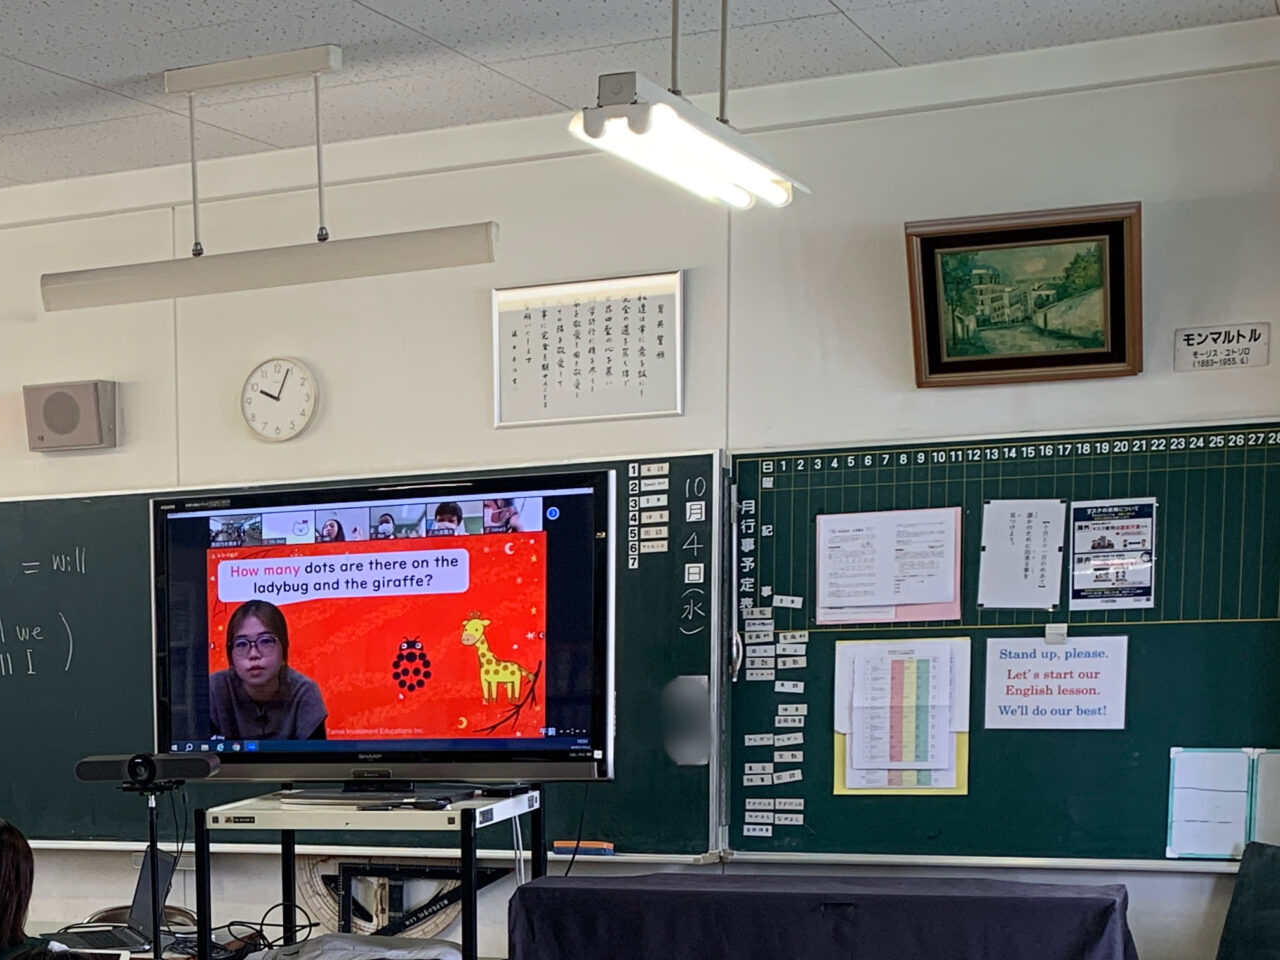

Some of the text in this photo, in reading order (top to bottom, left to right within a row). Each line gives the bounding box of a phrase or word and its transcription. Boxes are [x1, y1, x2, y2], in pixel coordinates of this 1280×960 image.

[1182, 329, 1261, 346] モンマルトル
[763, 461, 774, 472] 日
[781, 461, 786, 471] 1
[797, 460, 804, 470] 2
[814, 459, 822, 469] 3
[831, 458, 838, 468] 4
[847, 457, 855, 467] 5
[864, 456, 872, 466] 6
[882, 455, 889, 465] 7
[900, 454, 907, 464] 8
[917, 453, 925, 463] 9
[932, 452, 946, 463] 10
[950, 451, 962, 462] 11
[967, 450, 980, 461] 12
[985, 449, 999, 460] 13
[1003, 448, 1017, 459] 14
[1021, 447, 1035, 458] 15
[1039, 446, 1053, 456] 16
[1057, 445, 1072, 455] 17
[1076, 444, 1090, 454] 18
[1095, 442, 1109, 453] 19
[1113, 441, 1128, 452] 20
[1132, 440, 1146, 451] 21
[1151, 439, 1166, 450] 22
[1170, 438, 1185, 449] 23
[1189, 437, 1205, 448] 24
[1209, 436, 1225, 447] 25
[1228, 435, 1244, 446] 26
[1248, 434, 1264, 445] 27
[631, 465, 635, 474] 1
[631, 483, 637, 492] 2
[631, 499, 637, 508] 3
[630, 513, 637, 523] 4
[630, 529, 636, 538] 5
[630, 543, 637, 553] 6
[53, 547, 86, 574] will
[230, 555, 458, 577] How many dots are there on the
[630, 557, 637, 567] 7
[253, 574, 433, 596] ladybug and the giraffe?
[16, 625, 44, 641] we
[1000, 648, 1109, 661] Stand up, please.
[27, 649, 36, 674] I
[1043, 670, 1074, 679] start
[1078, 671, 1100, 679] our
[1005, 685, 1100, 697] English lesson.
[998, 705, 1107, 716] We'll do our best!
